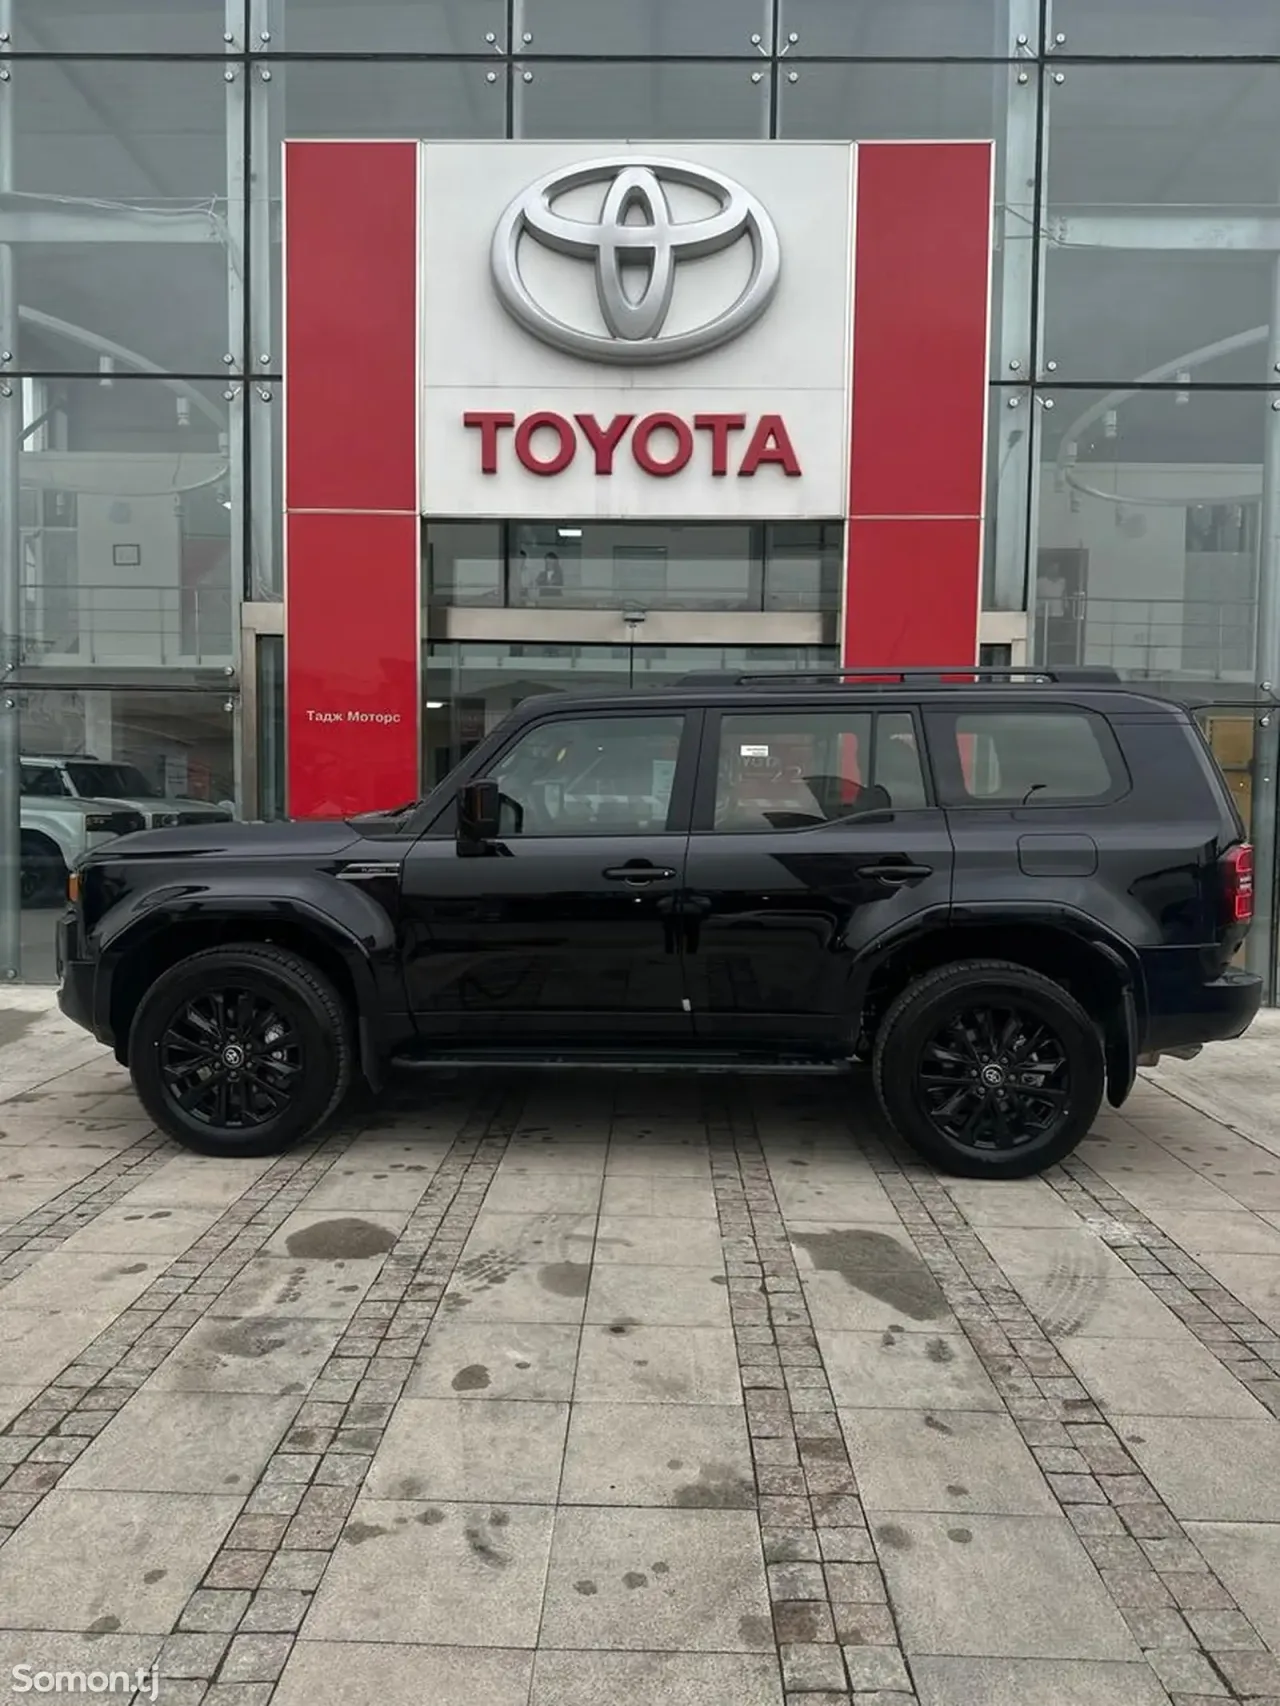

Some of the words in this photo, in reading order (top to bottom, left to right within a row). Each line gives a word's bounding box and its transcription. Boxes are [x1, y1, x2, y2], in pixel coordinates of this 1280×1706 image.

[463, 411, 802, 476] TOYOTA
[306, 710, 343, 723] Тадж
[347, 711, 401, 725] Моторс
